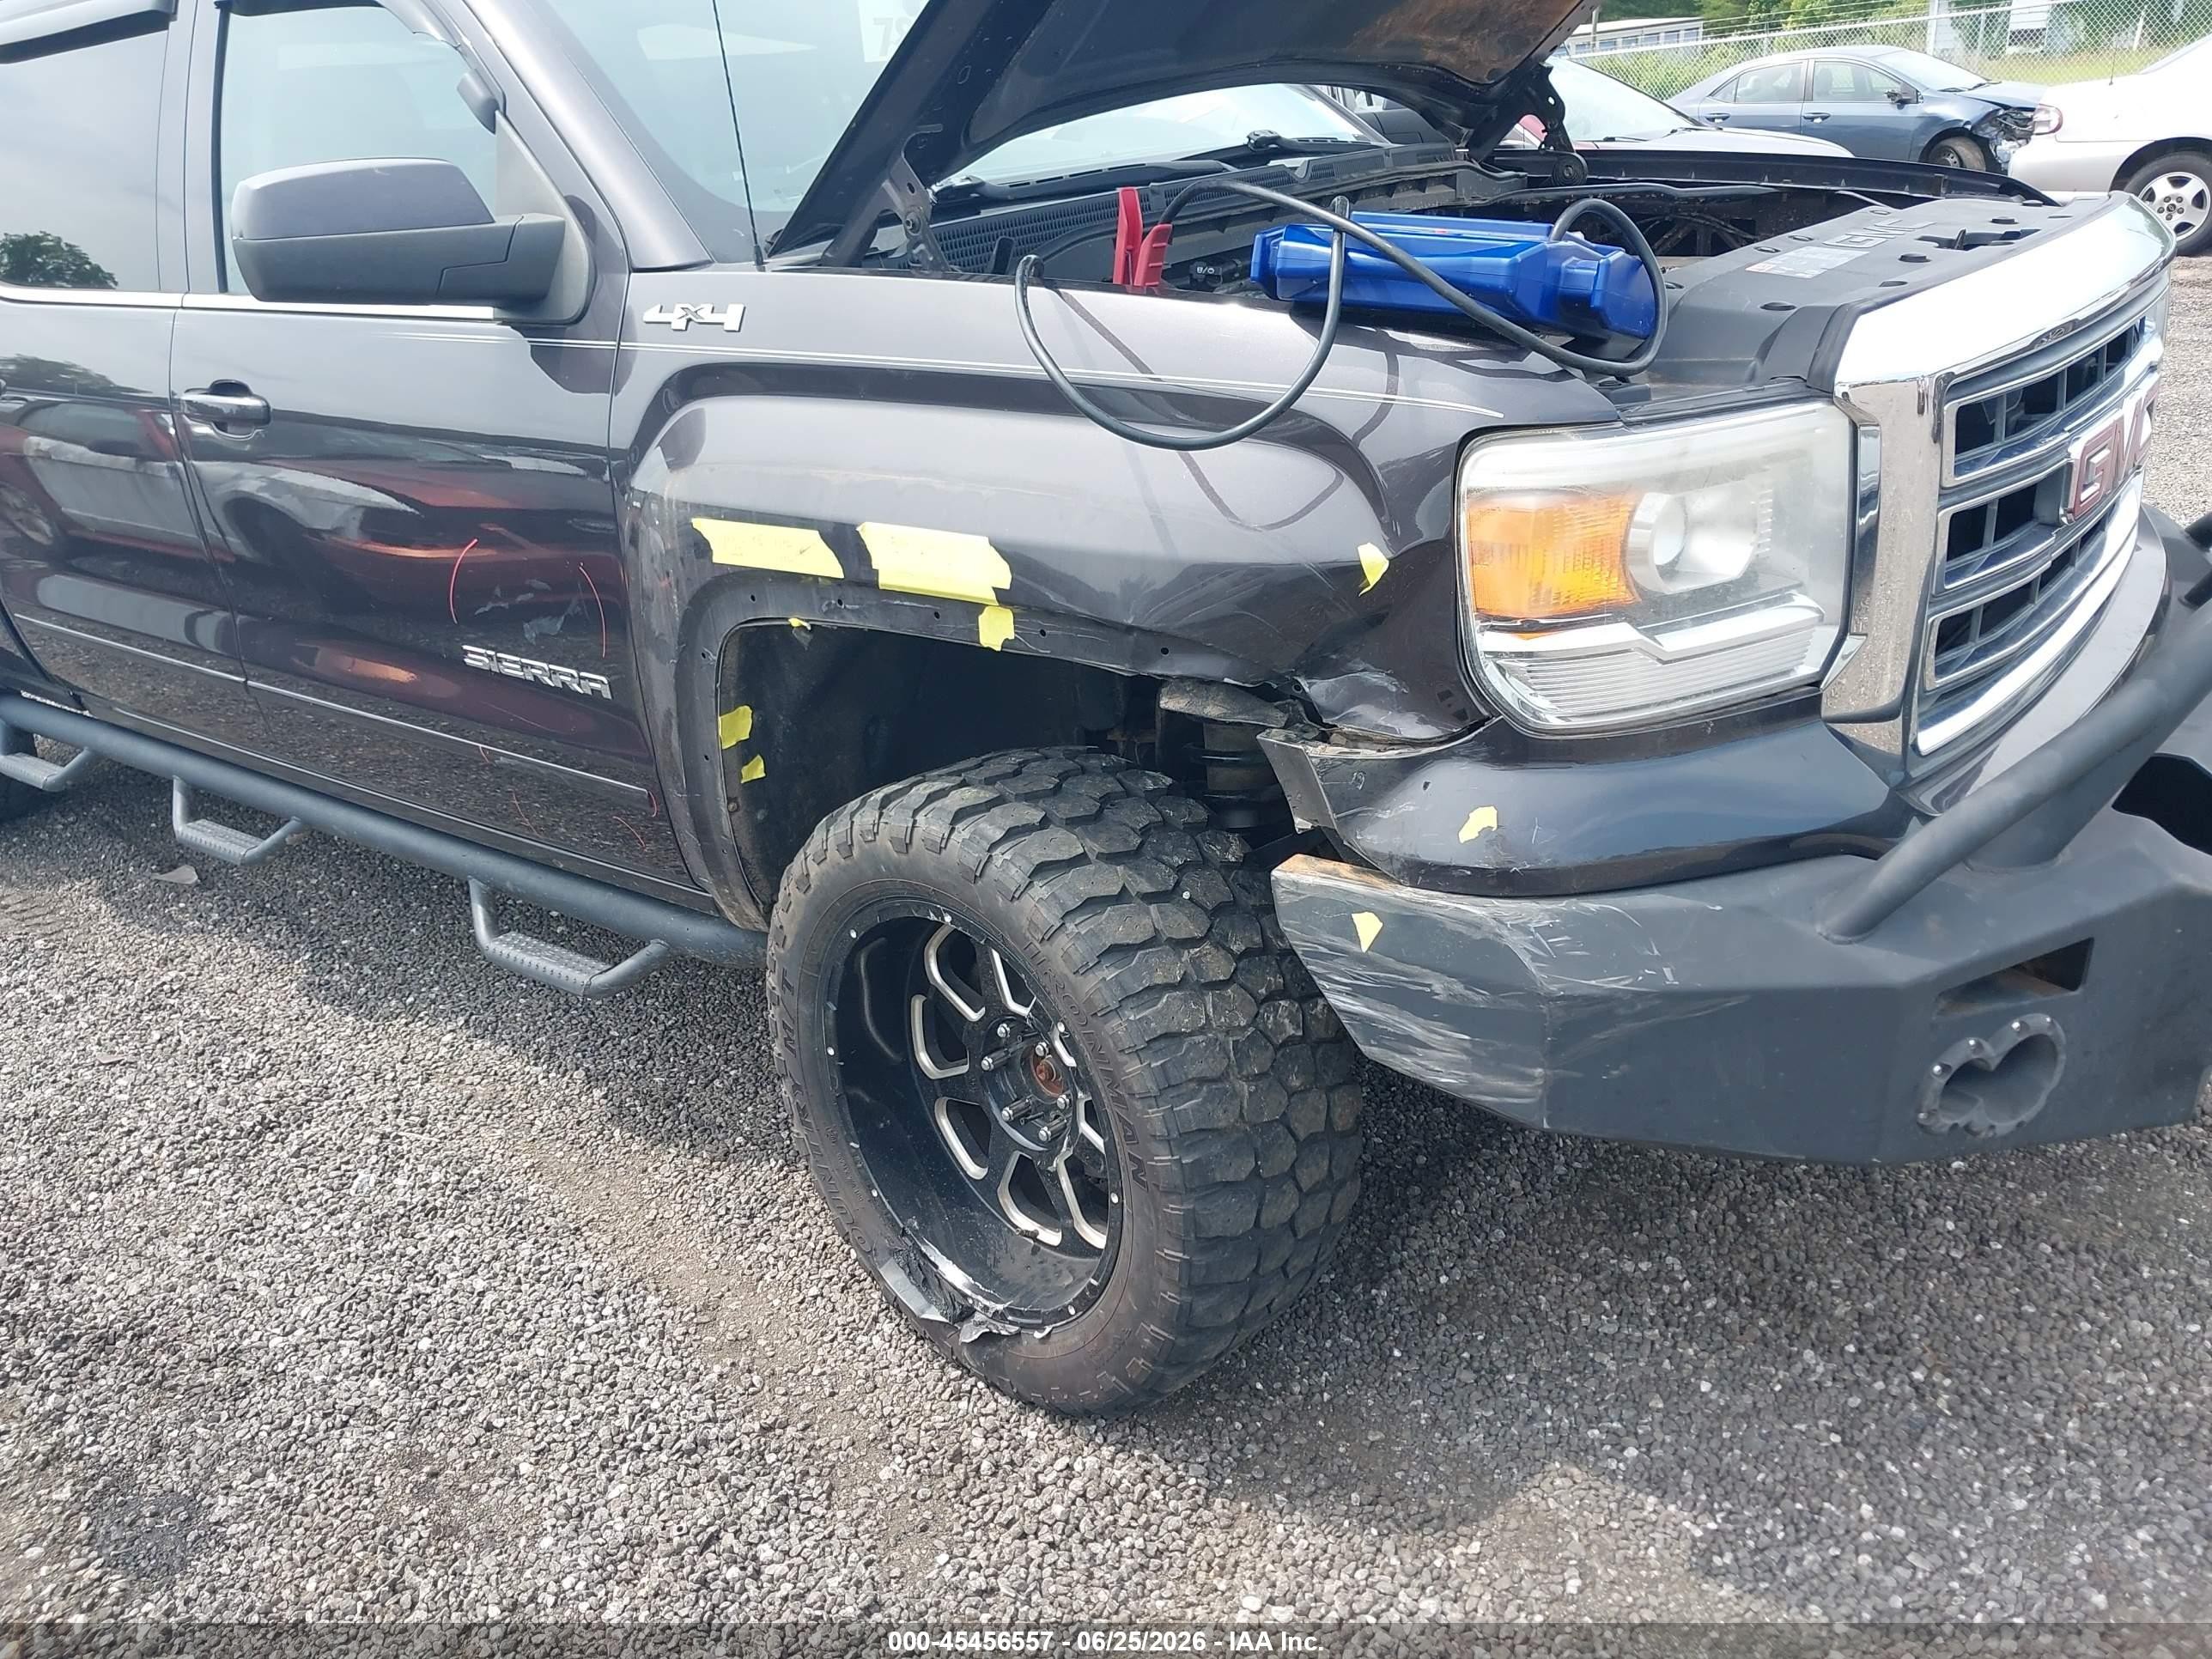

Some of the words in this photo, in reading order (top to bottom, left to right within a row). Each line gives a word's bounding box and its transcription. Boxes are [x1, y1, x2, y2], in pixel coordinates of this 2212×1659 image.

[1823, 218, 1936, 249] GMC
[2069, 373, 2160, 522] GMC
[462, 645, 613, 700] SIERRA
[1024, 941, 1149, 1192] IRONMAN
[789, 1076, 875, 1254] OUNTRY
